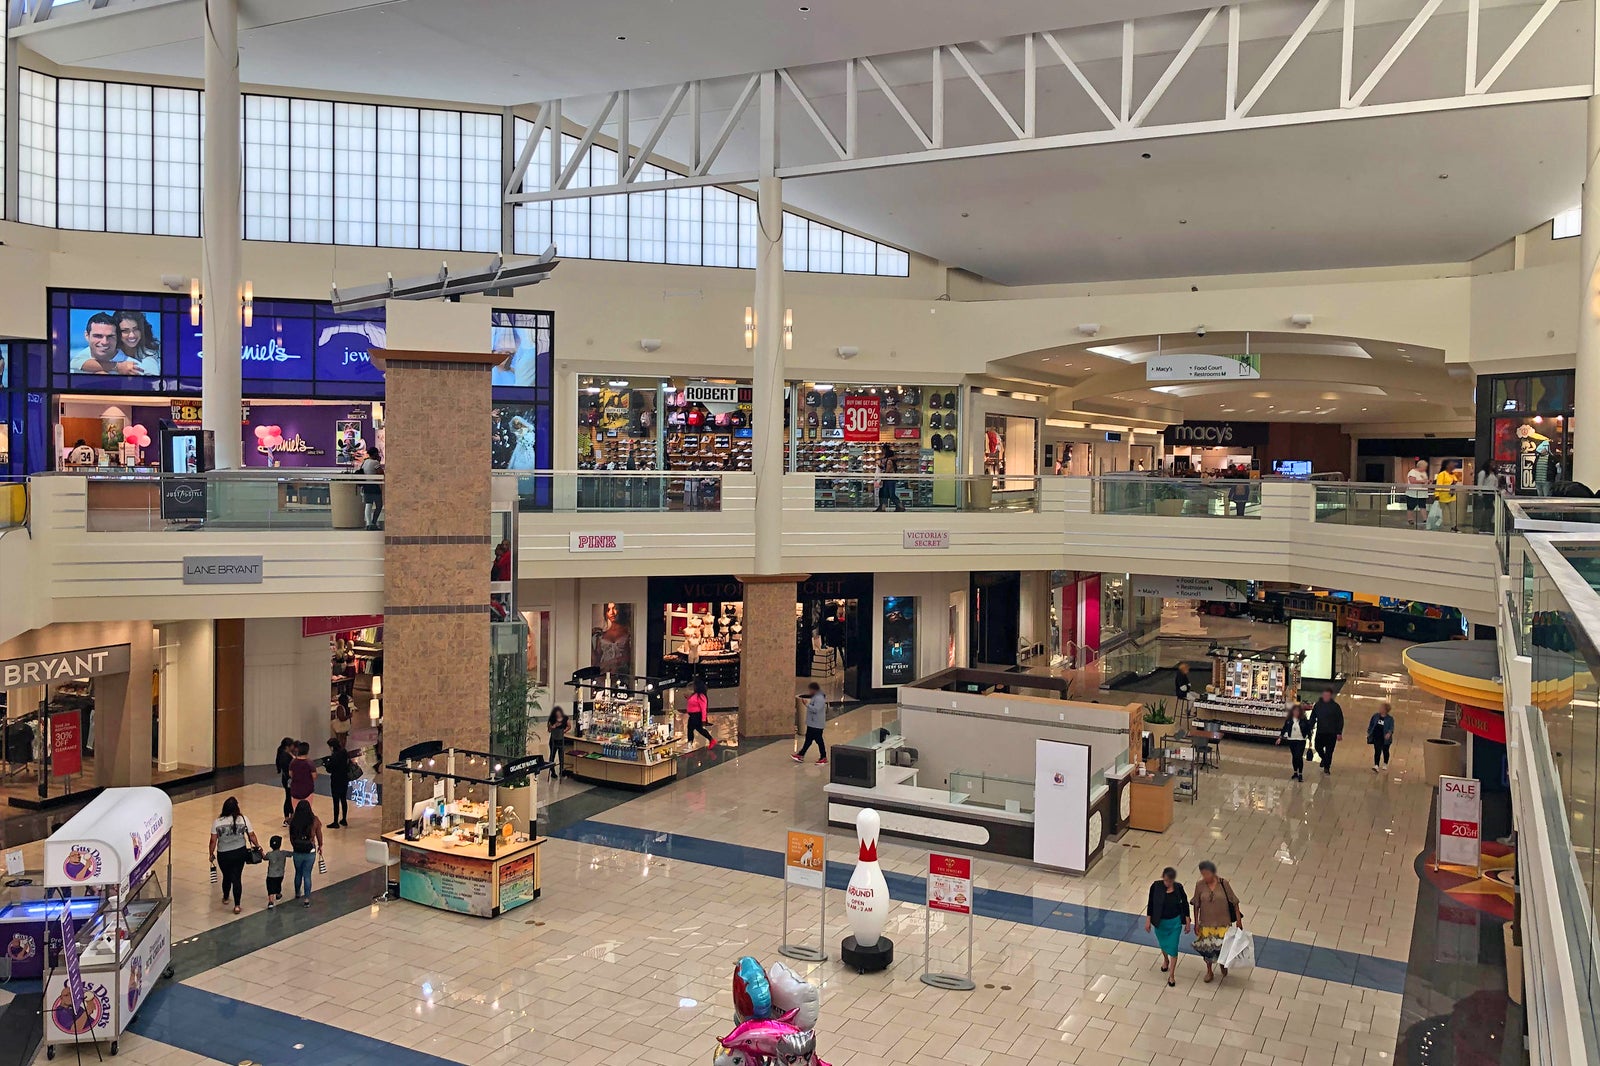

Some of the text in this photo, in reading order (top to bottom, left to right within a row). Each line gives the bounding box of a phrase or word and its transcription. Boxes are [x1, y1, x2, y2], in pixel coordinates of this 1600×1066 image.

[686, 387, 736, 401] ROBERT
[171, 405, 181, 413] UP
[181, 406, 203, 420] 8
[867, 420, 879, 428] OFF
[1174, 423, 1233, 444] macy's
[80, 452, 91, 462] 34
[906, 531, 949, 540] VICTORIA'S
[578, 535, 617, 549] PINK
[914, 539, 942, 547] SECRET
[187, 564, 259, 575] LANE BRYANT
[4, 651, 109, 687] BRYANT
[55, 731, 73, 741] 30%
[55, 740, 69, 748] OFF
[1445, 782, 1476, 795] SALE
[71, 844, 91, 854] Gus
